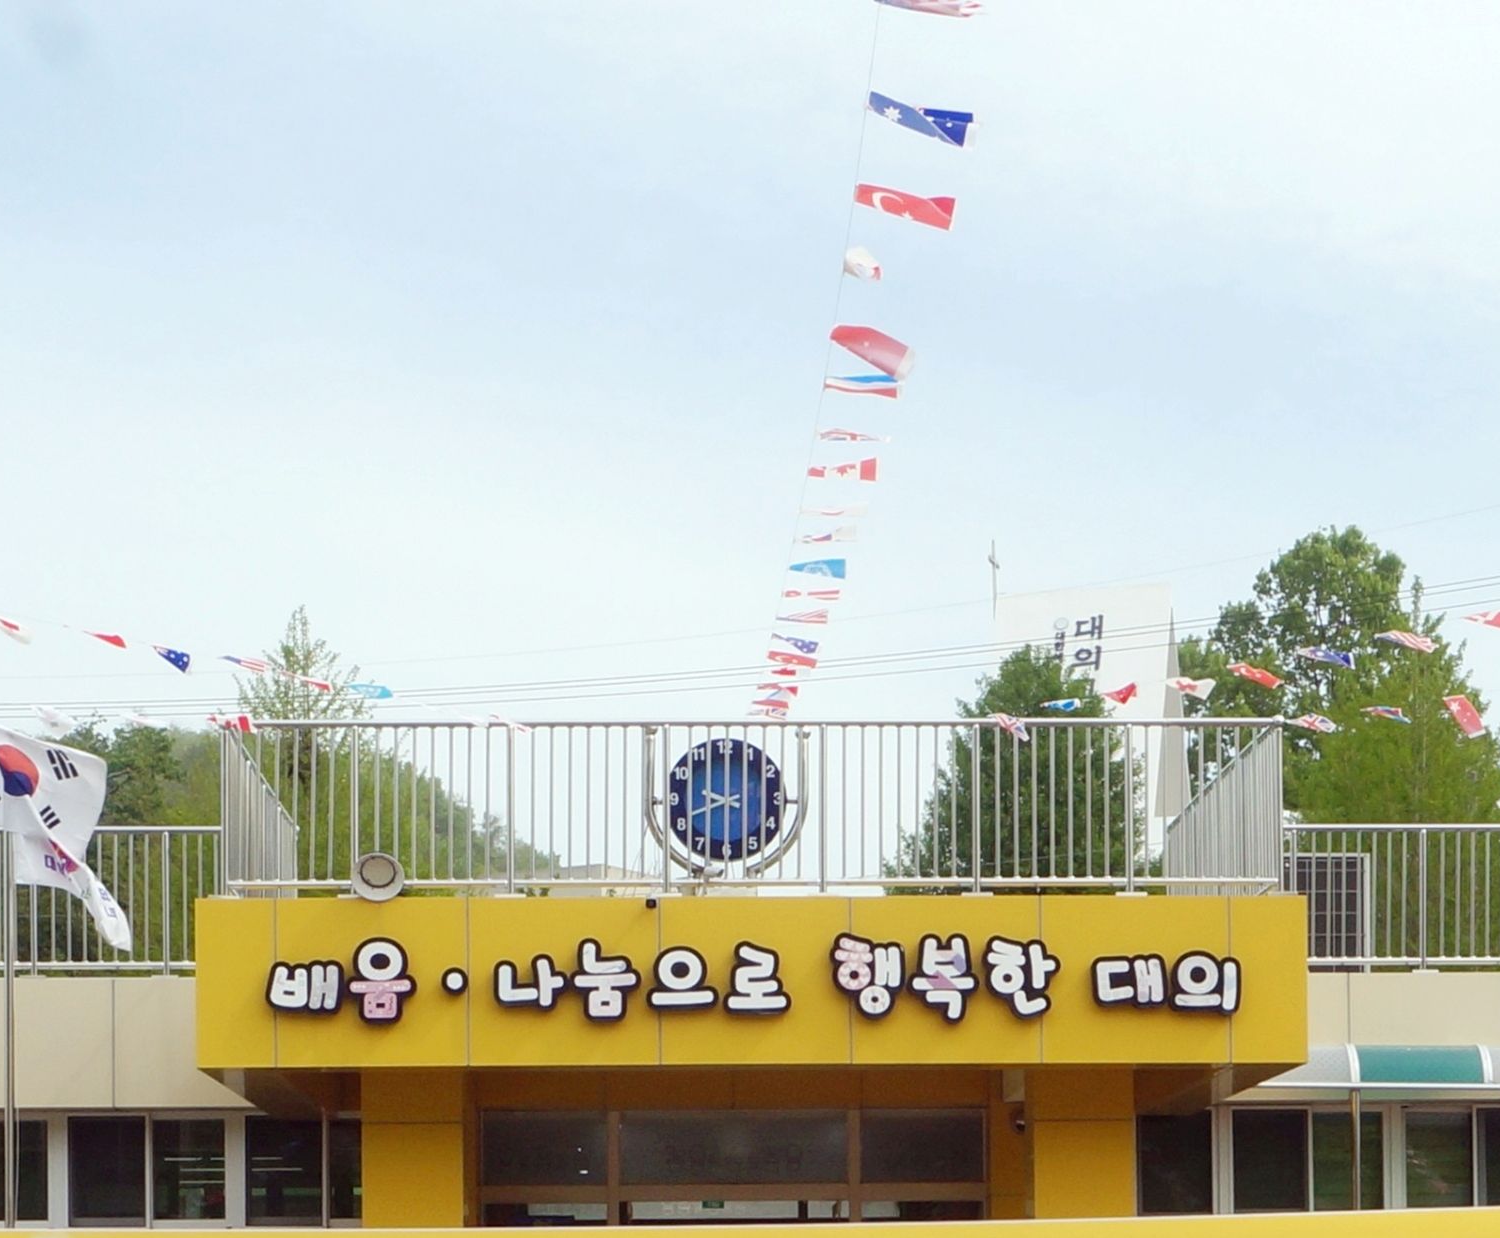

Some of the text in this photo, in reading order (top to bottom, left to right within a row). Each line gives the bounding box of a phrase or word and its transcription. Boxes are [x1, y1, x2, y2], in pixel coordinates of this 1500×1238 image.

[1070, 614, 1104, 694] 대의
[692, 748, 705, 760] 11
[716, 741, 733, 754] 12
[747, 748, 754, 760] 1
[674, 767, 688, 780] 10
[766, 765, 775, 778] 2
[670, 793, 679, 805] 9
[773, 792, 783, 805] 3
[677, 818, 686, 831] 8
[766, 816, 776, 829] 4
[695, 837, 705, 850] 7
[722, 843, 732, 857] 6
[748, 837, 758, 850] 5
[264, 937, 418, 1027] 배움
[492, 938, 792, 1024] 나눔으로
[830, 932, 1061, 1025] 행복한
[1090, 950, 1242, 1018] 대의
